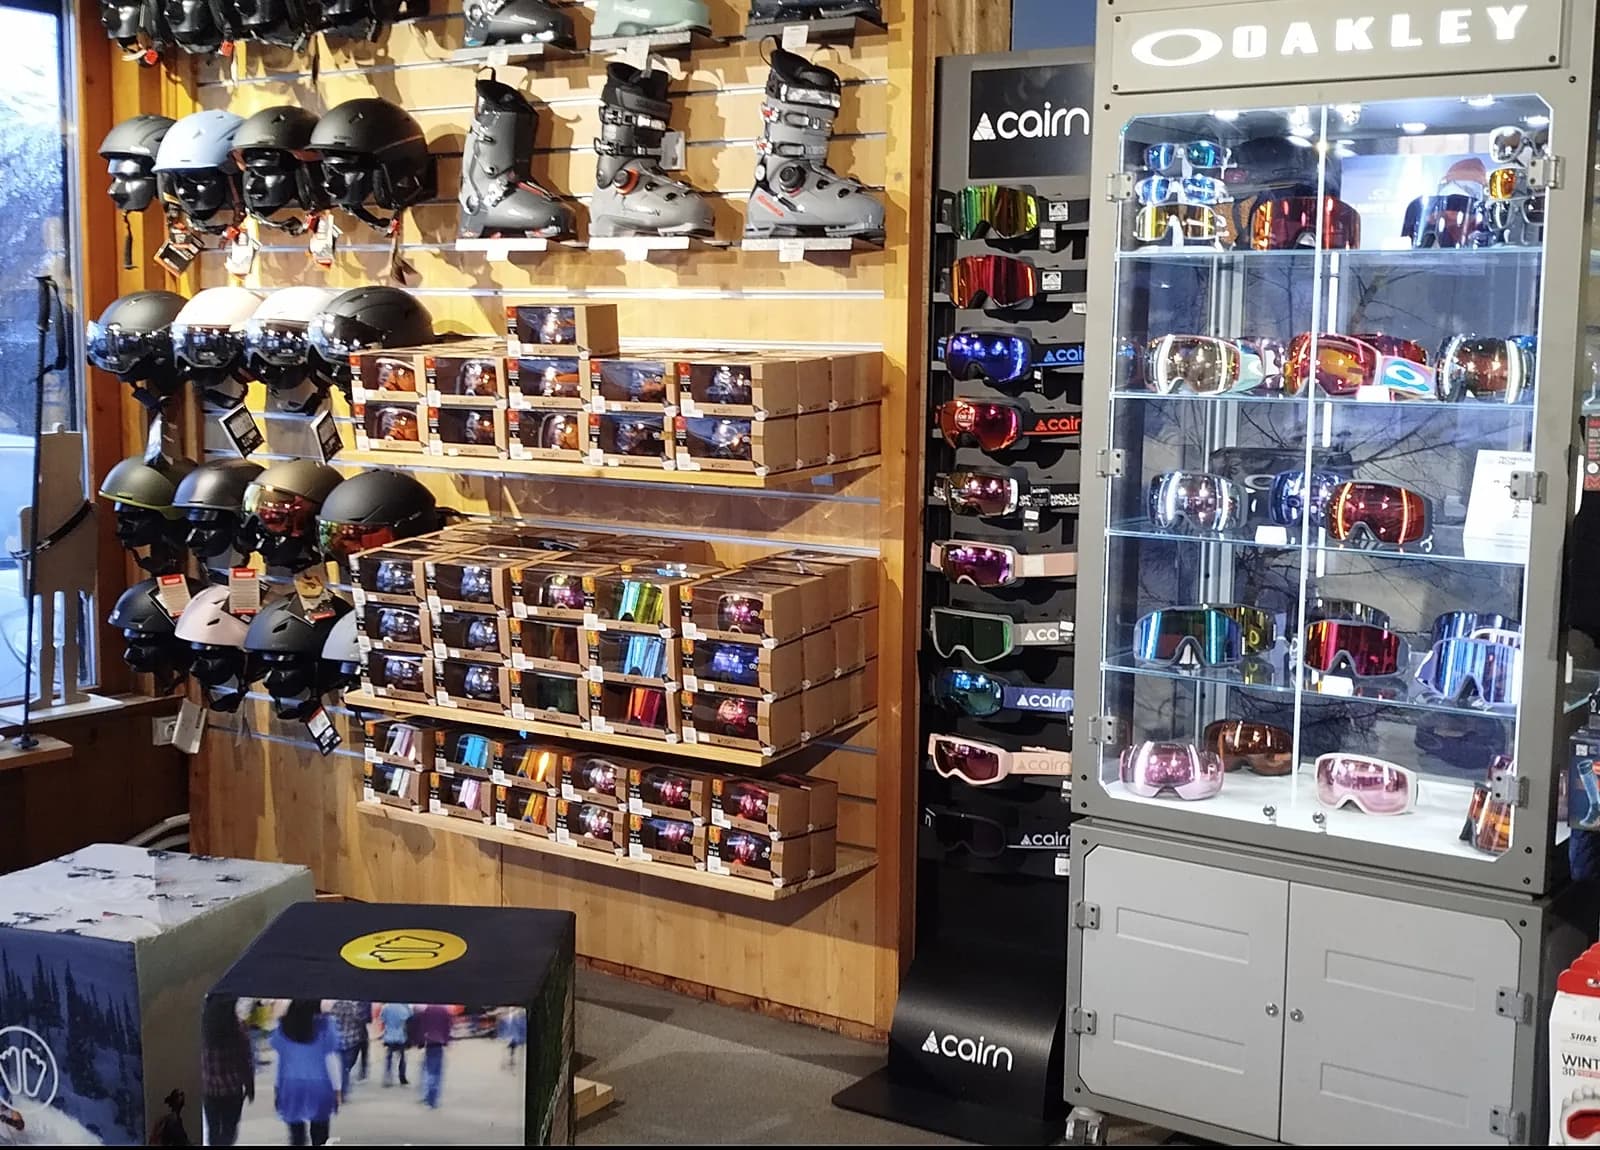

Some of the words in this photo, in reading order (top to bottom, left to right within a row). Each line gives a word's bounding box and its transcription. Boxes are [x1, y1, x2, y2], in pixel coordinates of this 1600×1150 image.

[1231, 4, 1528, 59] OAKLEY
[996, 101, 1090, 140] cairn
[1055, 345, 1085, 362] cai
[1028, 693, 1074, 709] cairn
[1570, 1033, 1597, 1043] SIDAS
[940, 1034, 1014, 1072] cairn
[1562, 1067, 1576, 1077] 3D
